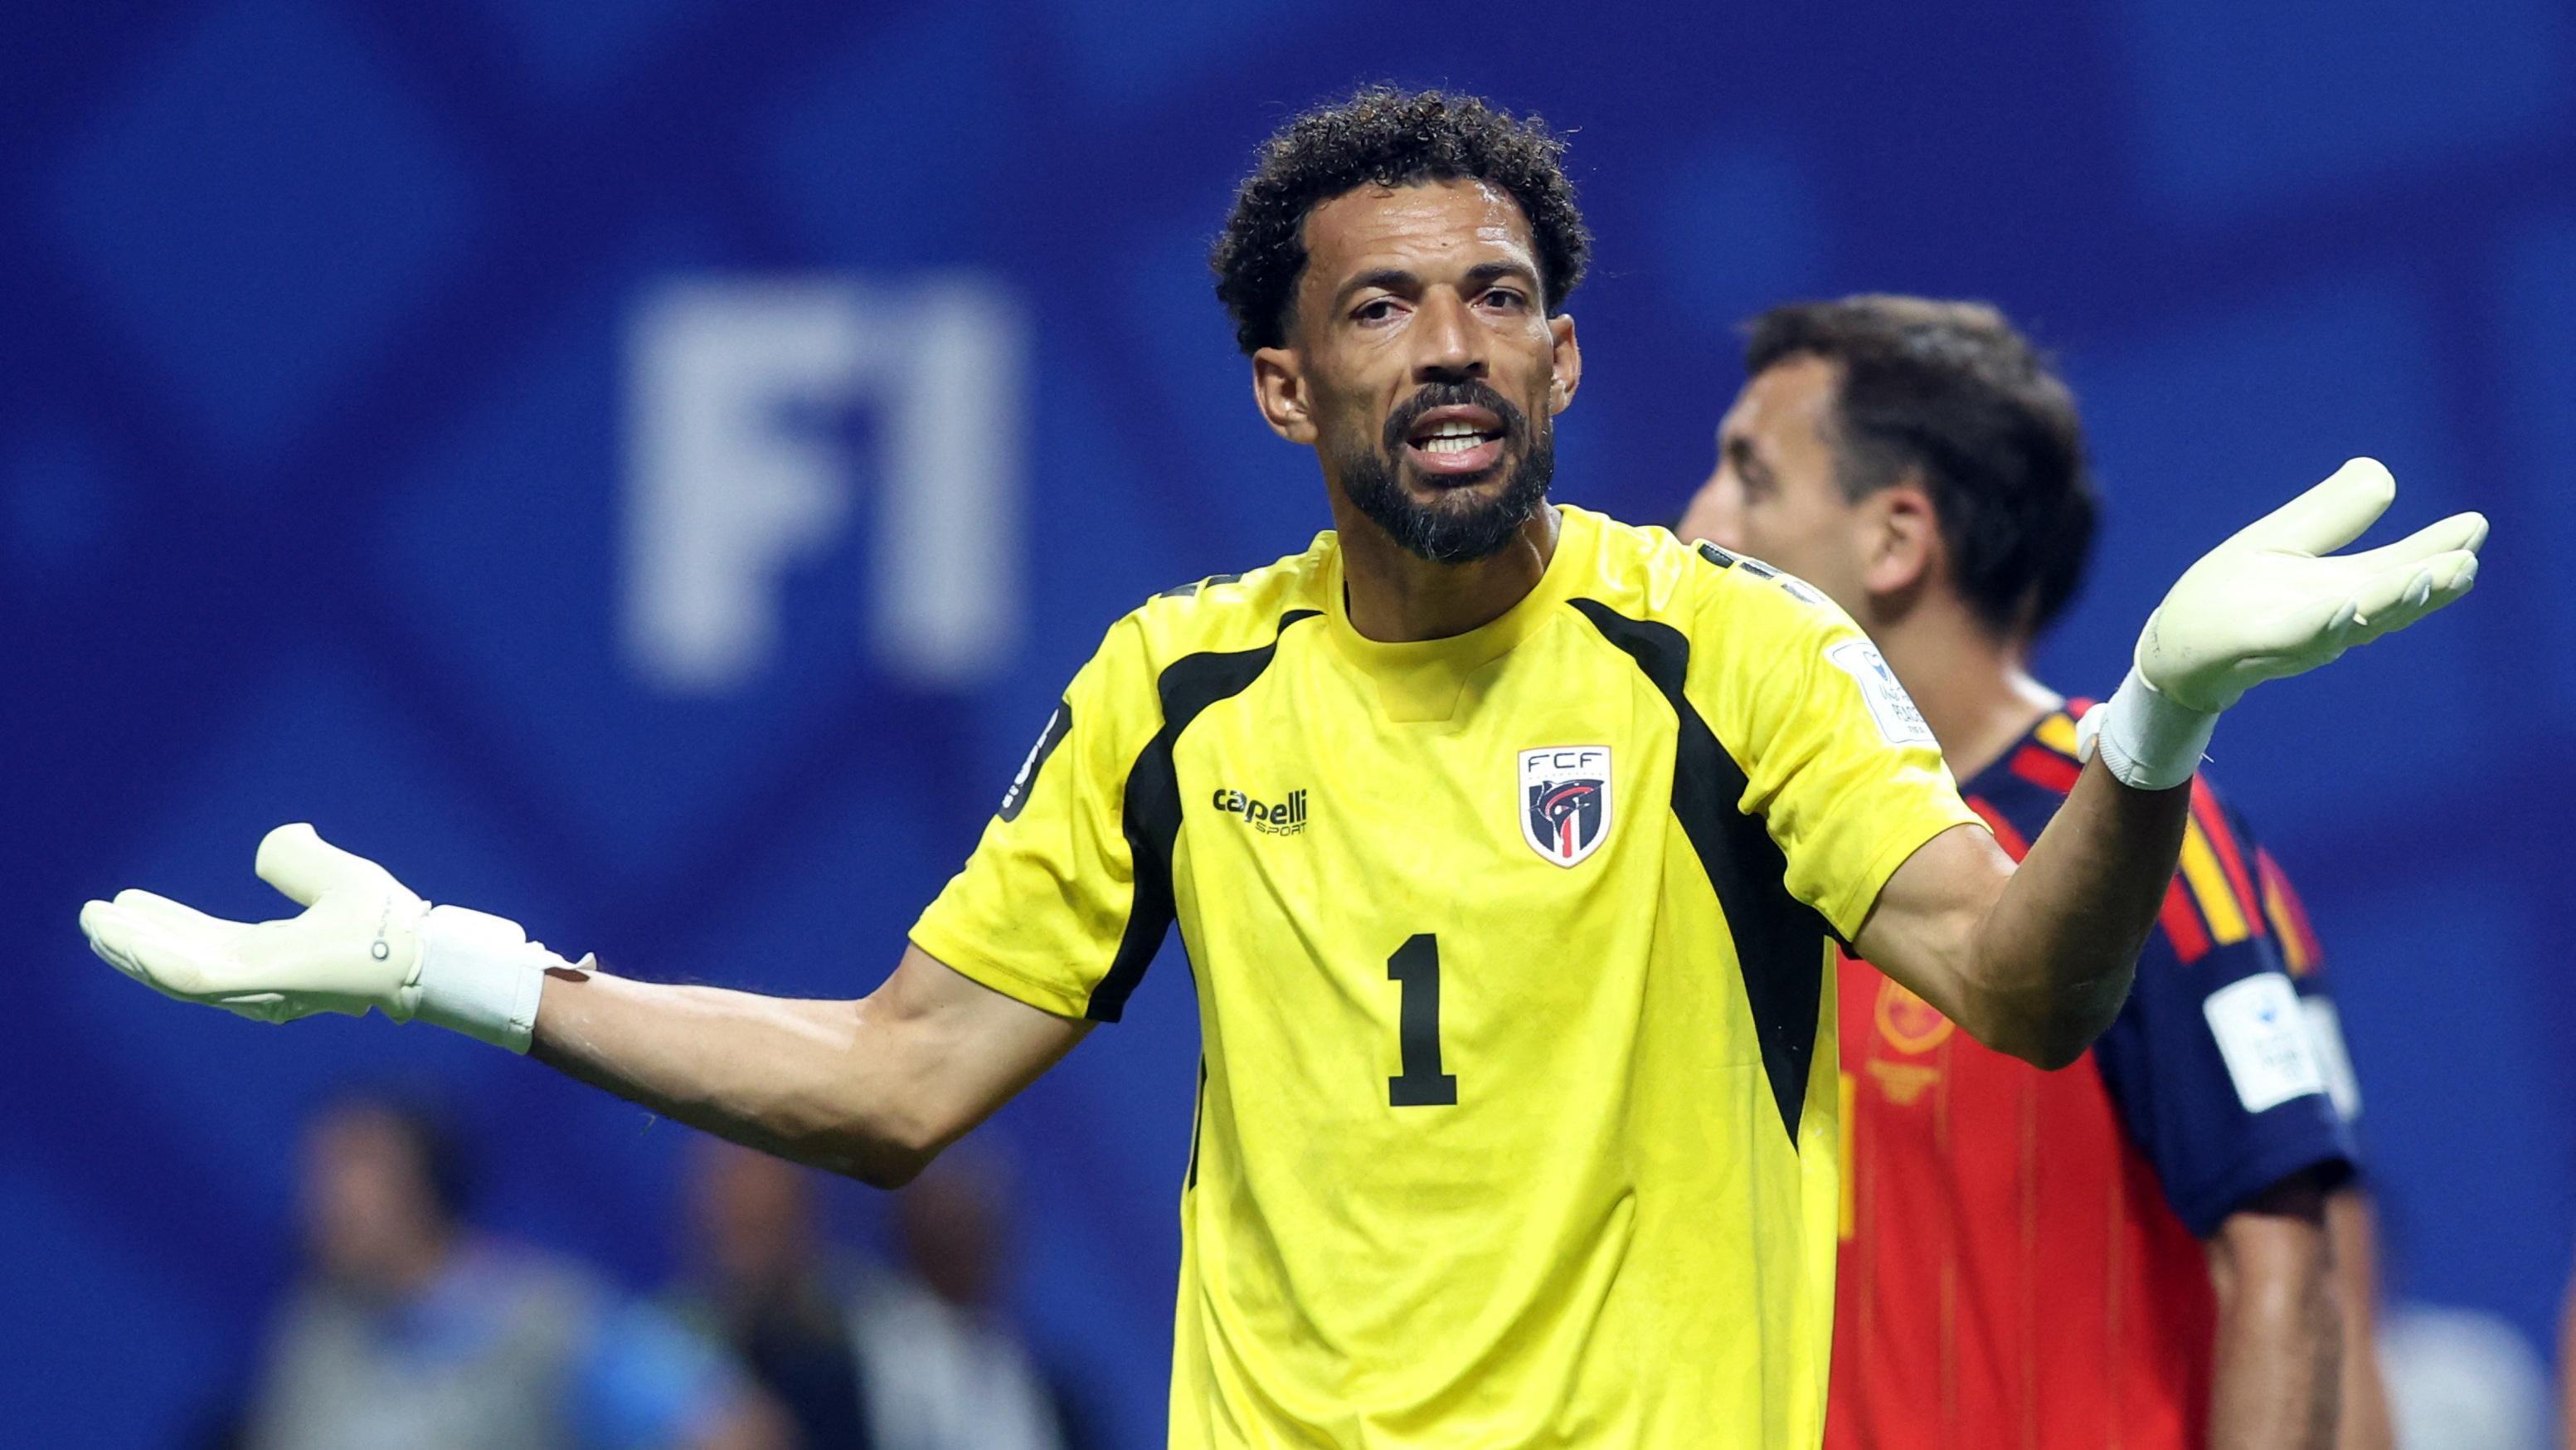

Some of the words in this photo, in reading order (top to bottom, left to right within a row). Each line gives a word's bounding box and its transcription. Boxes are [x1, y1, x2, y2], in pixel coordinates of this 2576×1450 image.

[1528, 752, 1602, 773] FCF
[1213, 788, 1307, 825] capelli
[1255, 820, 1307, 837] SPORT
[1387, 932, 1458, 1107] 1
